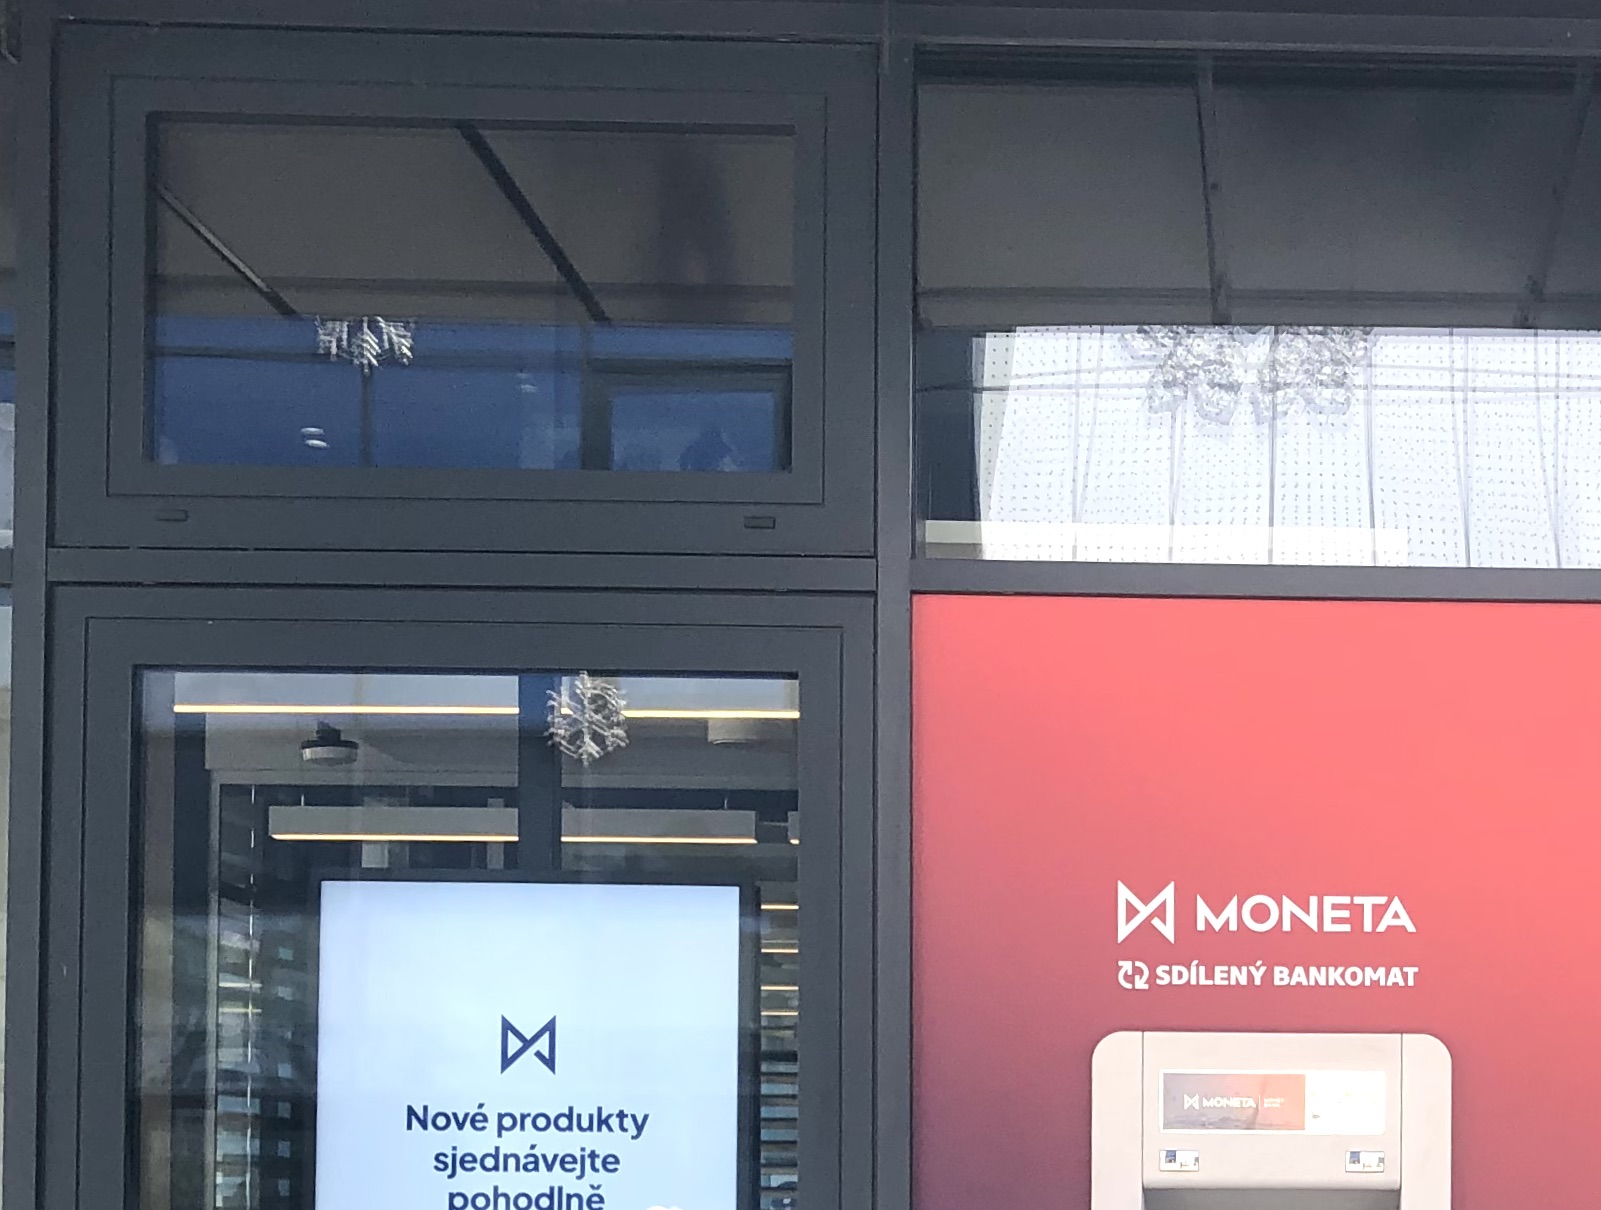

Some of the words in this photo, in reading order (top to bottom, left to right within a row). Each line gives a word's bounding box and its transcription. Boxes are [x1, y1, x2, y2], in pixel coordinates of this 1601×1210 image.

[1196, 893, 1417, 933] MONETA
[1155, 959, 1267, 986] SDÍLENÝ
[1273, 966, 1419, 987] BANKOMAT
[1202, 1096, 1257, 1108] MONETA
[405, 1103, 489, 1132] Nové
[497, 1105, 650, 1140] produkty
[433, 1144, 621, 1180] sjednávejte
